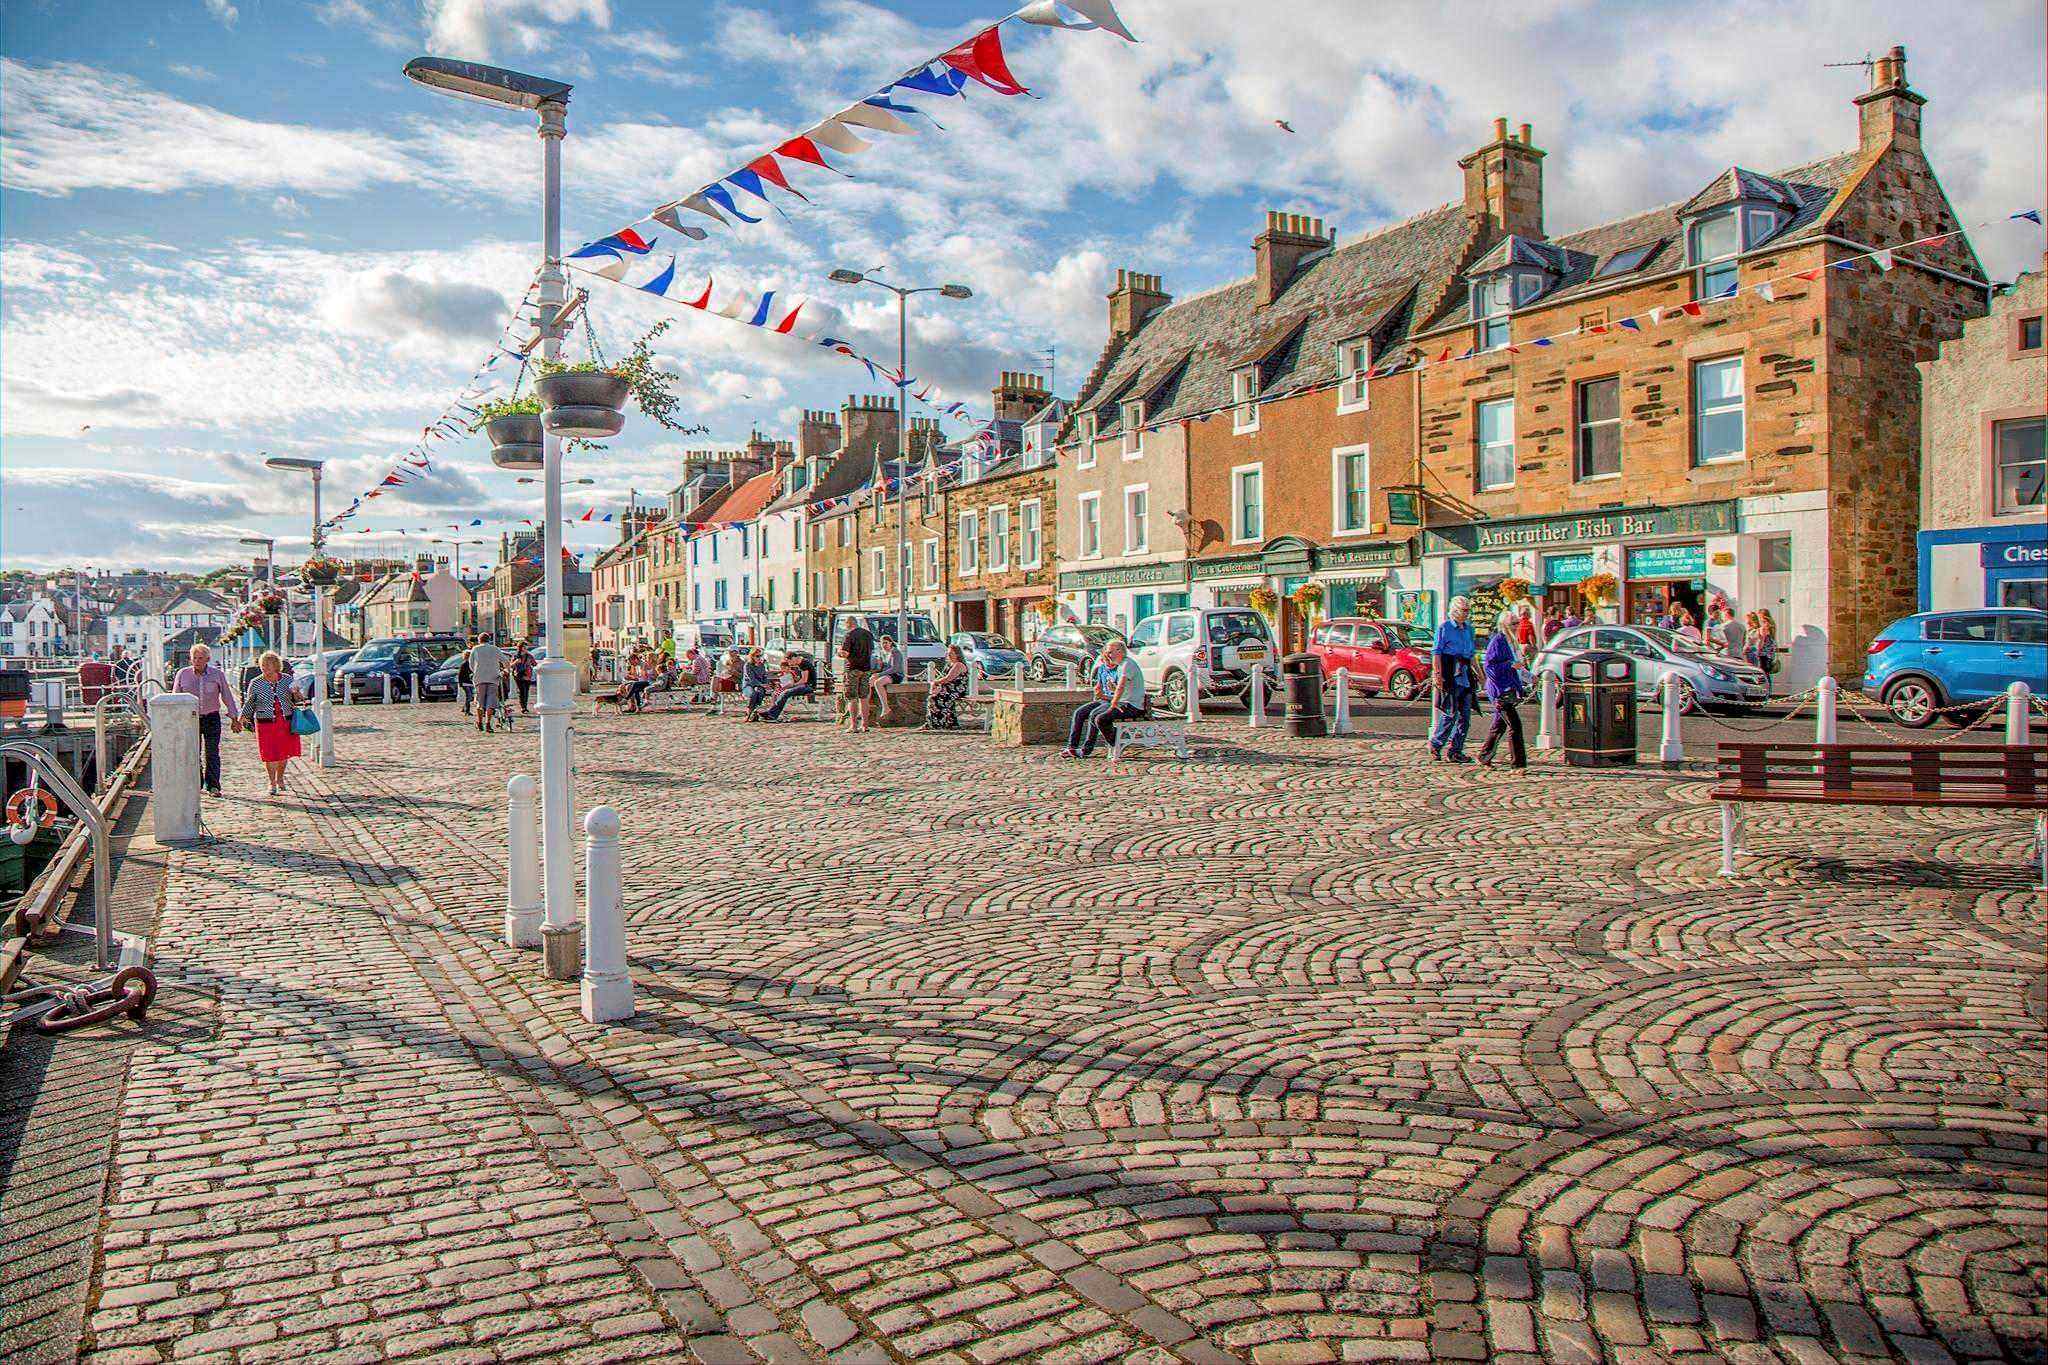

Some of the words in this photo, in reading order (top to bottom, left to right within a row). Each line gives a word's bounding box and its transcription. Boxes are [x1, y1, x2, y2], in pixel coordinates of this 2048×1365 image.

[1480, 524, 1569, 546] Anstruther
[1575, 517, 1613, 539] Fish
[1622, 514, 1655, 535] Bar
[1329, 552, 1346, 564] Fish
[1349, 551, 1392, 562] Restaurant
